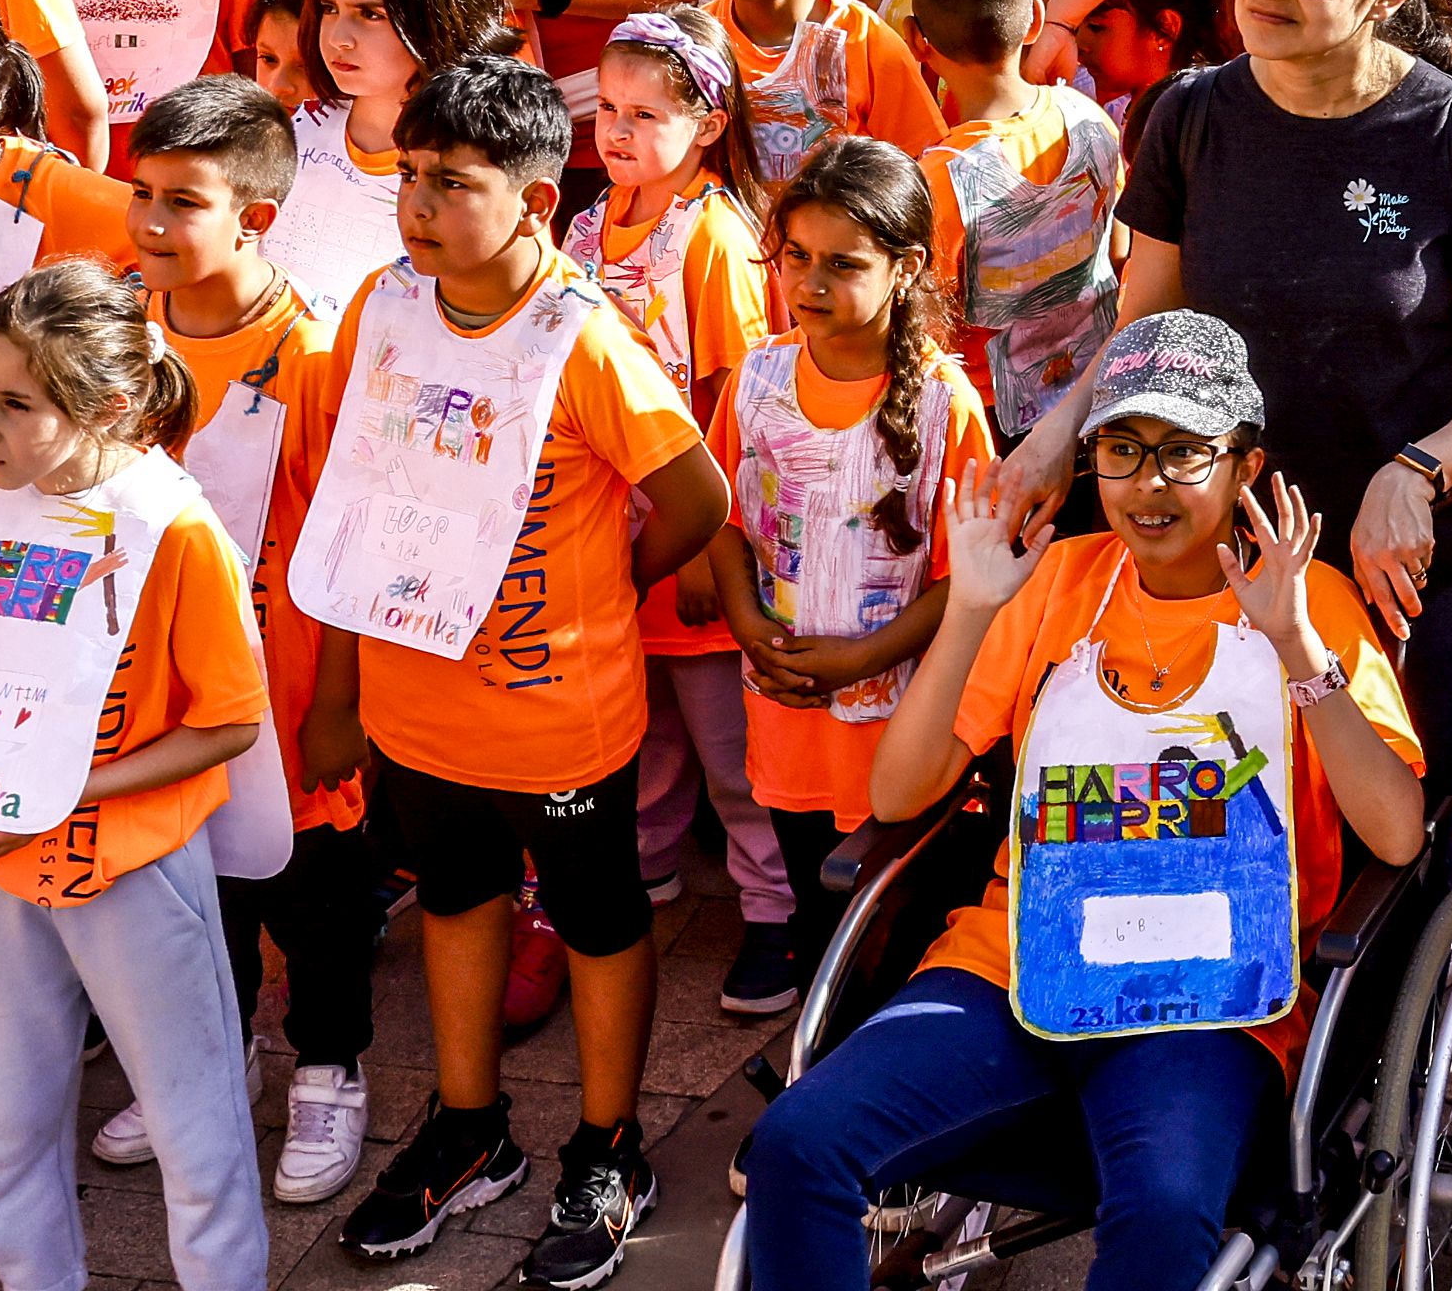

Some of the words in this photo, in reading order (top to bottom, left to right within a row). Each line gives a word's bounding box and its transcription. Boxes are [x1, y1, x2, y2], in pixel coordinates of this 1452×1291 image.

[1379, 192, 1410, 206] Make
[1104, 352, 1153, 380] NEW
[1156, 350, 1217, 380] YORK
[1039, 760, 1227, 804] HARRO
